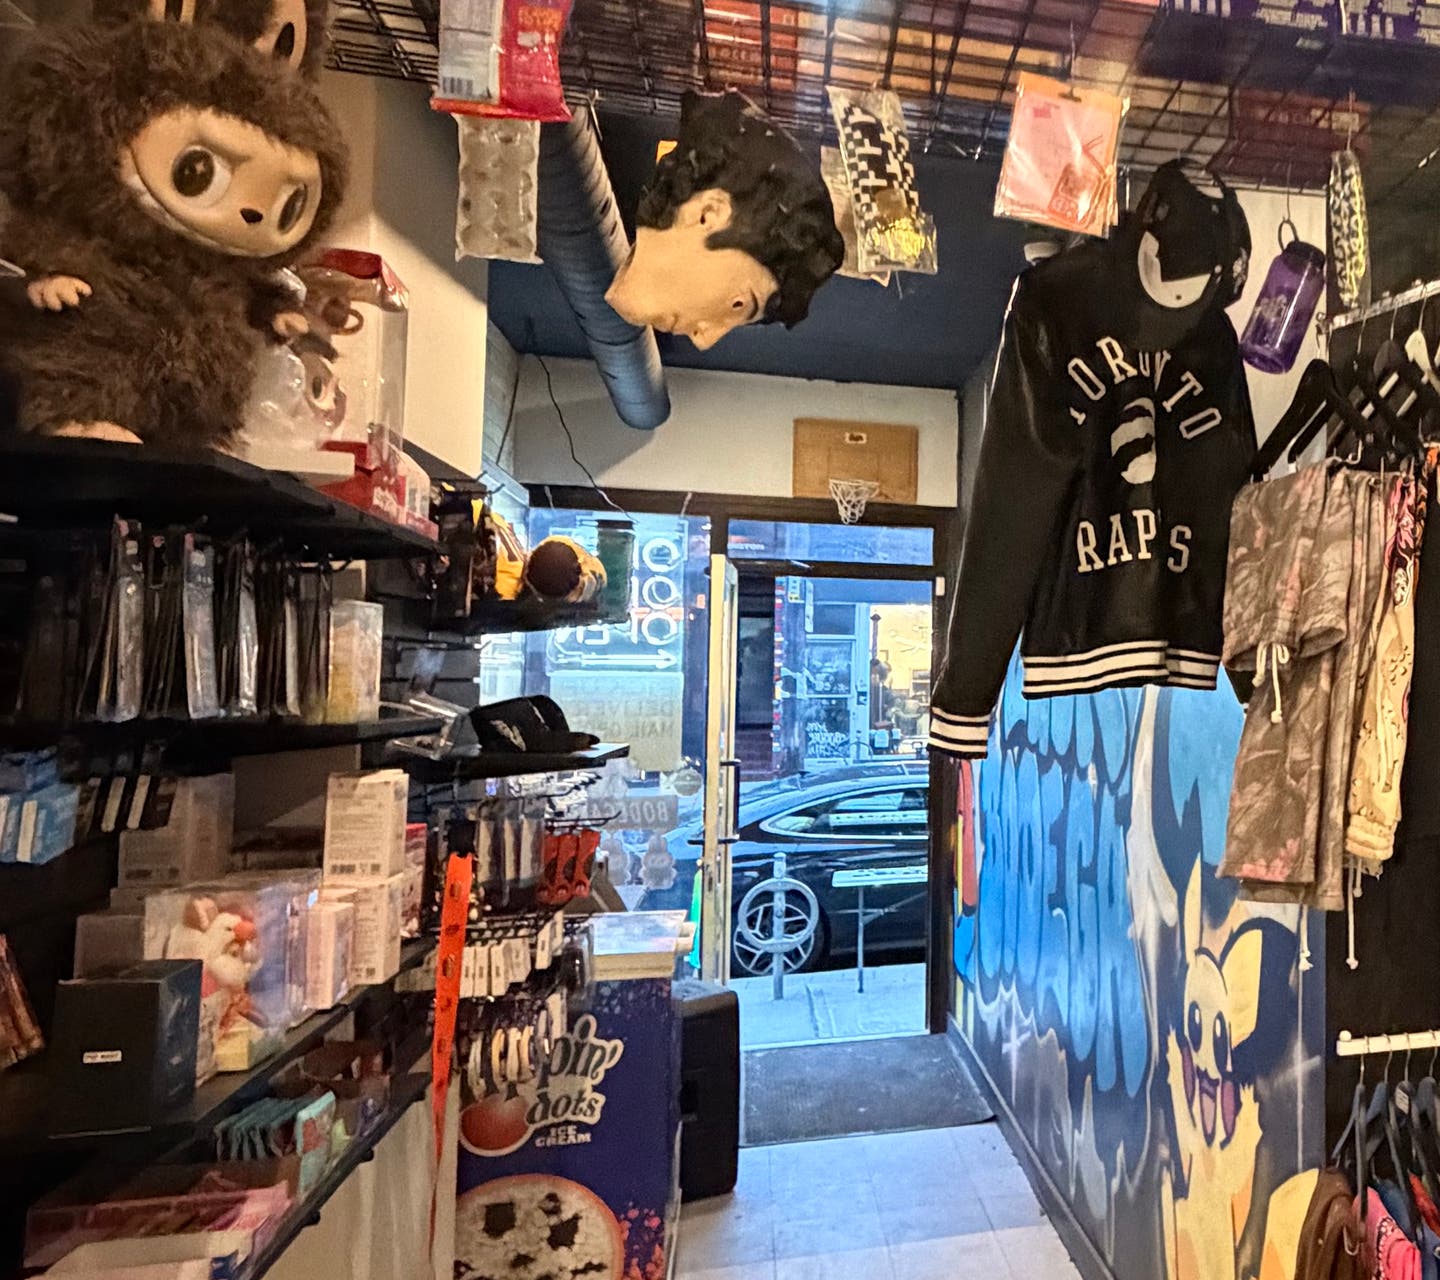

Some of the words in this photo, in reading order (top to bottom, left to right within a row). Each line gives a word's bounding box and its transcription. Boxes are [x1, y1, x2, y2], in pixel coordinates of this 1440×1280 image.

[1068, 335, 1223, 440] ORONTO
[1076, 508, 1192, 574] RAPS
[527, 1089, 600, 1125] dots
[535, 1131, 593, 1148] CREAM
[548, 1124, 578, 1136] ICE
